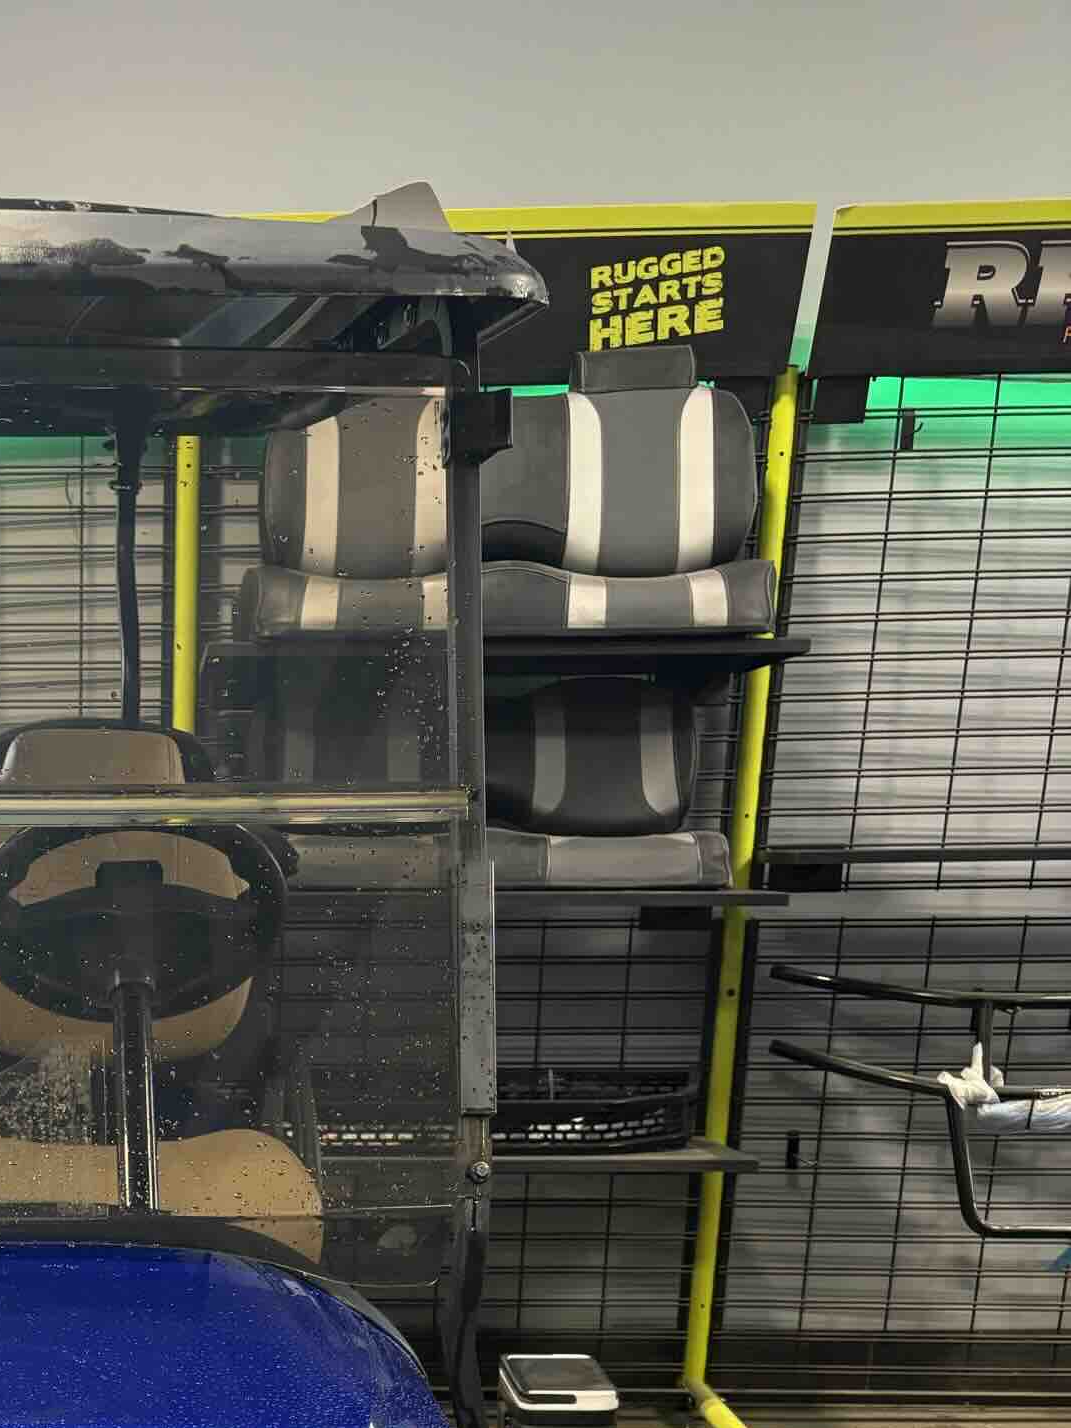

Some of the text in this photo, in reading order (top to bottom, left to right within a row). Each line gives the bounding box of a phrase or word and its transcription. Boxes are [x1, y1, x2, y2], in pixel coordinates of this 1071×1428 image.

[590, 246, 725, 289] RUGGED
[591, 271, 724, 315] STARTS
[589, 297, 725, 352] HERE
